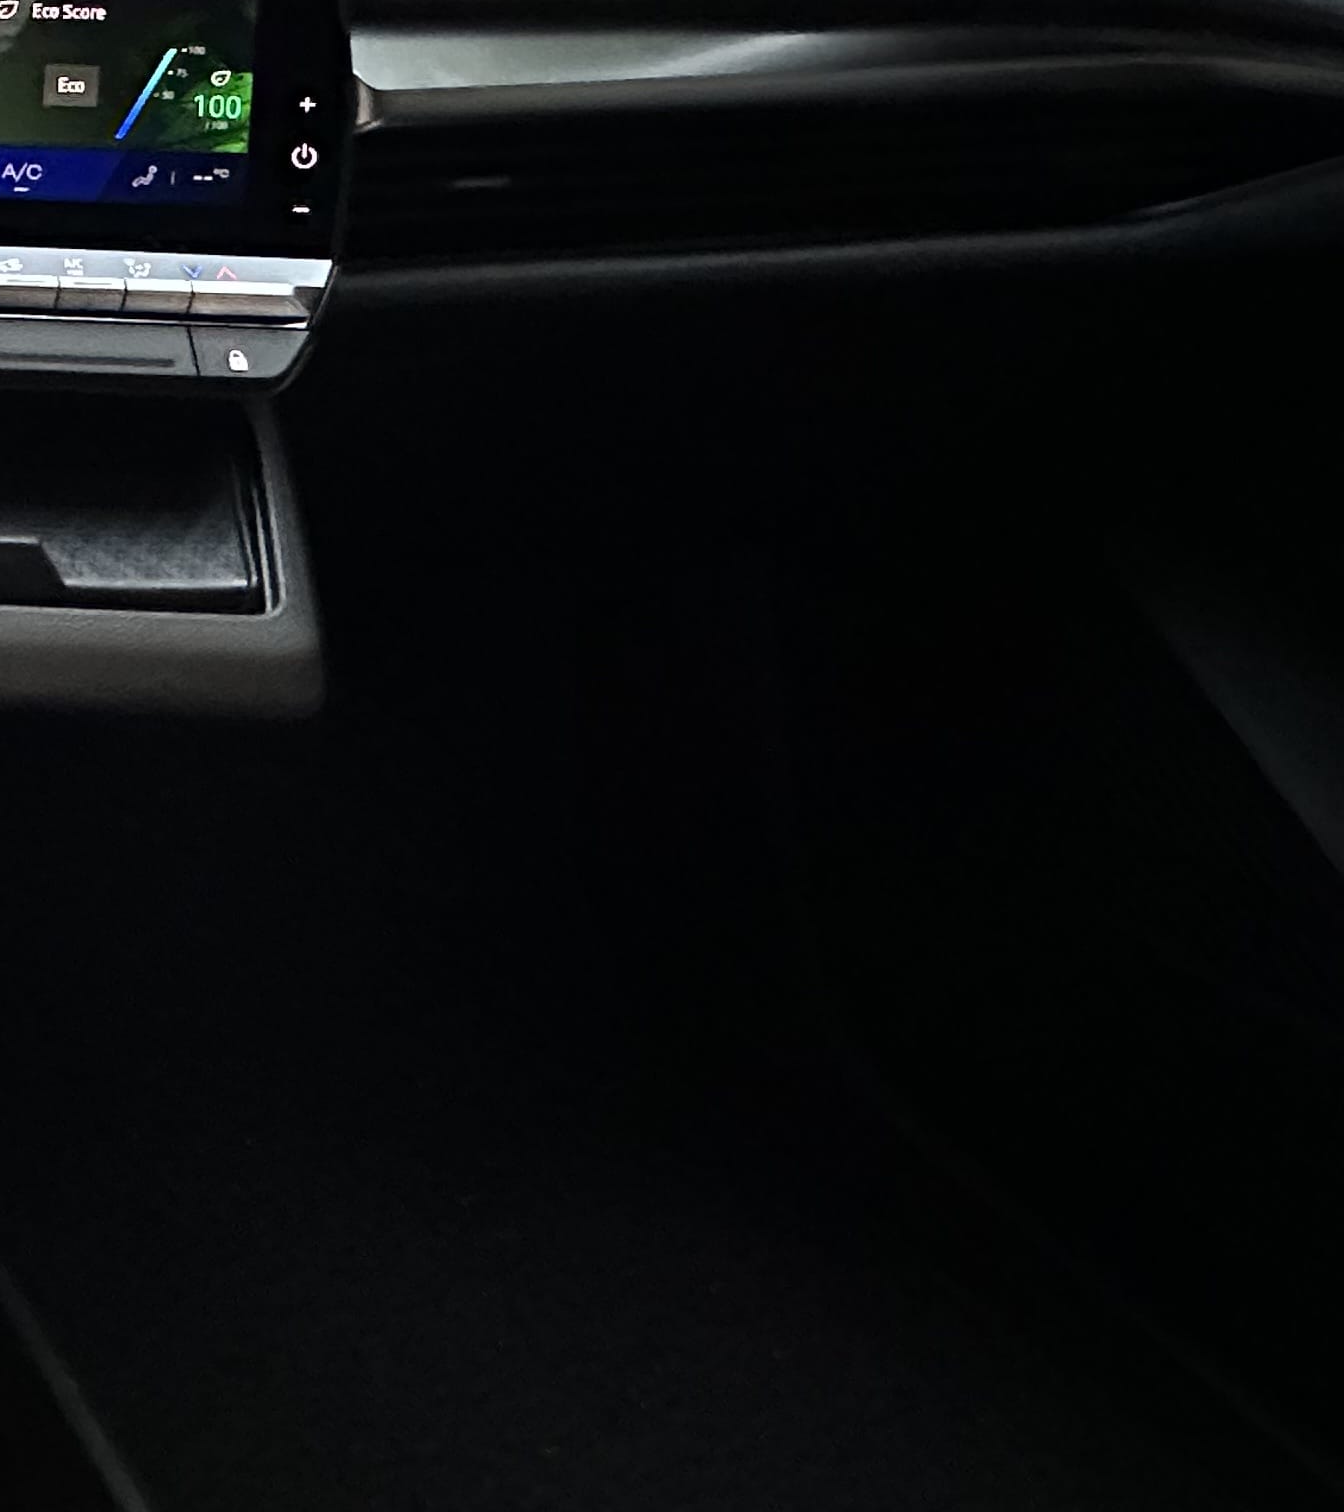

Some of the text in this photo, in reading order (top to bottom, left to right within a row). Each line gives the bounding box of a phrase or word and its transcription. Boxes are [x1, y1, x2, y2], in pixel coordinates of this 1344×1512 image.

[32, 2, 107, 21] Eco Score
[57, 76, 86, 93] Eco
[193, 94, 242, 119] 100
[1, 162, 43, 182] A/C
